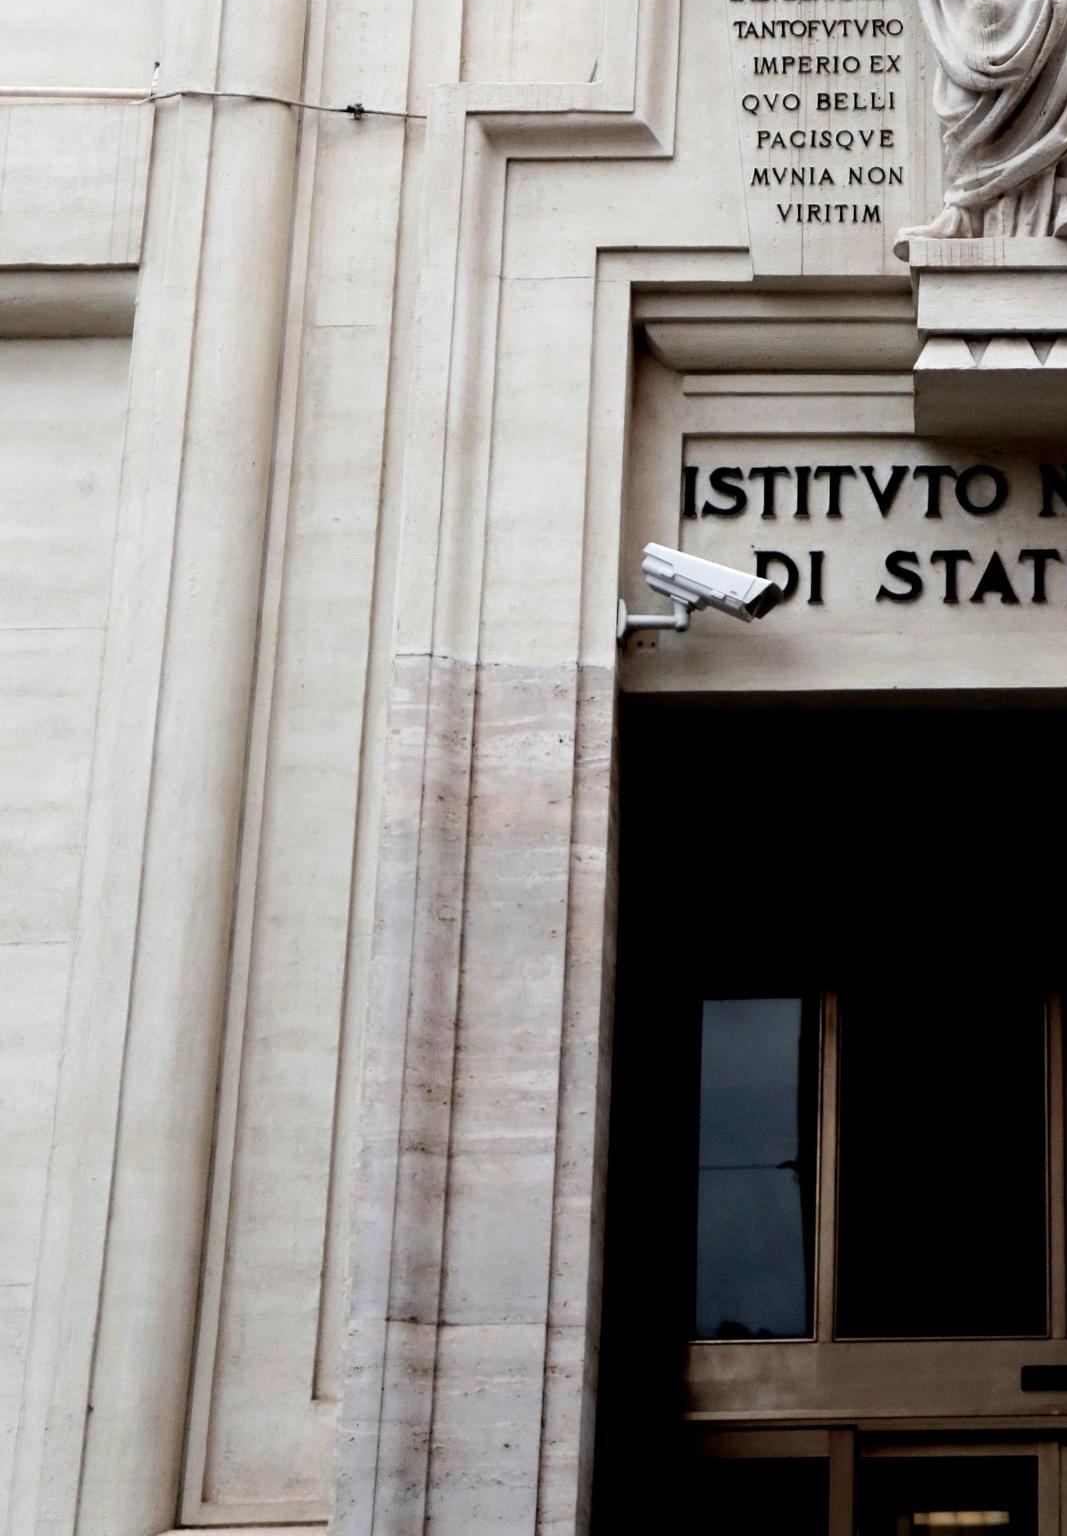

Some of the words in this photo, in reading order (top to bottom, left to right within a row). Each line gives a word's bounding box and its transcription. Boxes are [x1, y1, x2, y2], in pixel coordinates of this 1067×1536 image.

[753, 55, 861, 75] IMPERIO
[870, 55, 901, 73] EX
[742, 93, 801, 115] QVO
[816, 92, 896, 111] BELLI
[757, 129, 895, 150] PACISQVE
[751, 167, 835, 186] MVNIA
[848, 166, 904, 185] NON
[777, 204, 882, 223] VIRITIM
[682, 465, 1009, 519] ISTITVTO
[754, 550, 825, 605] DI
